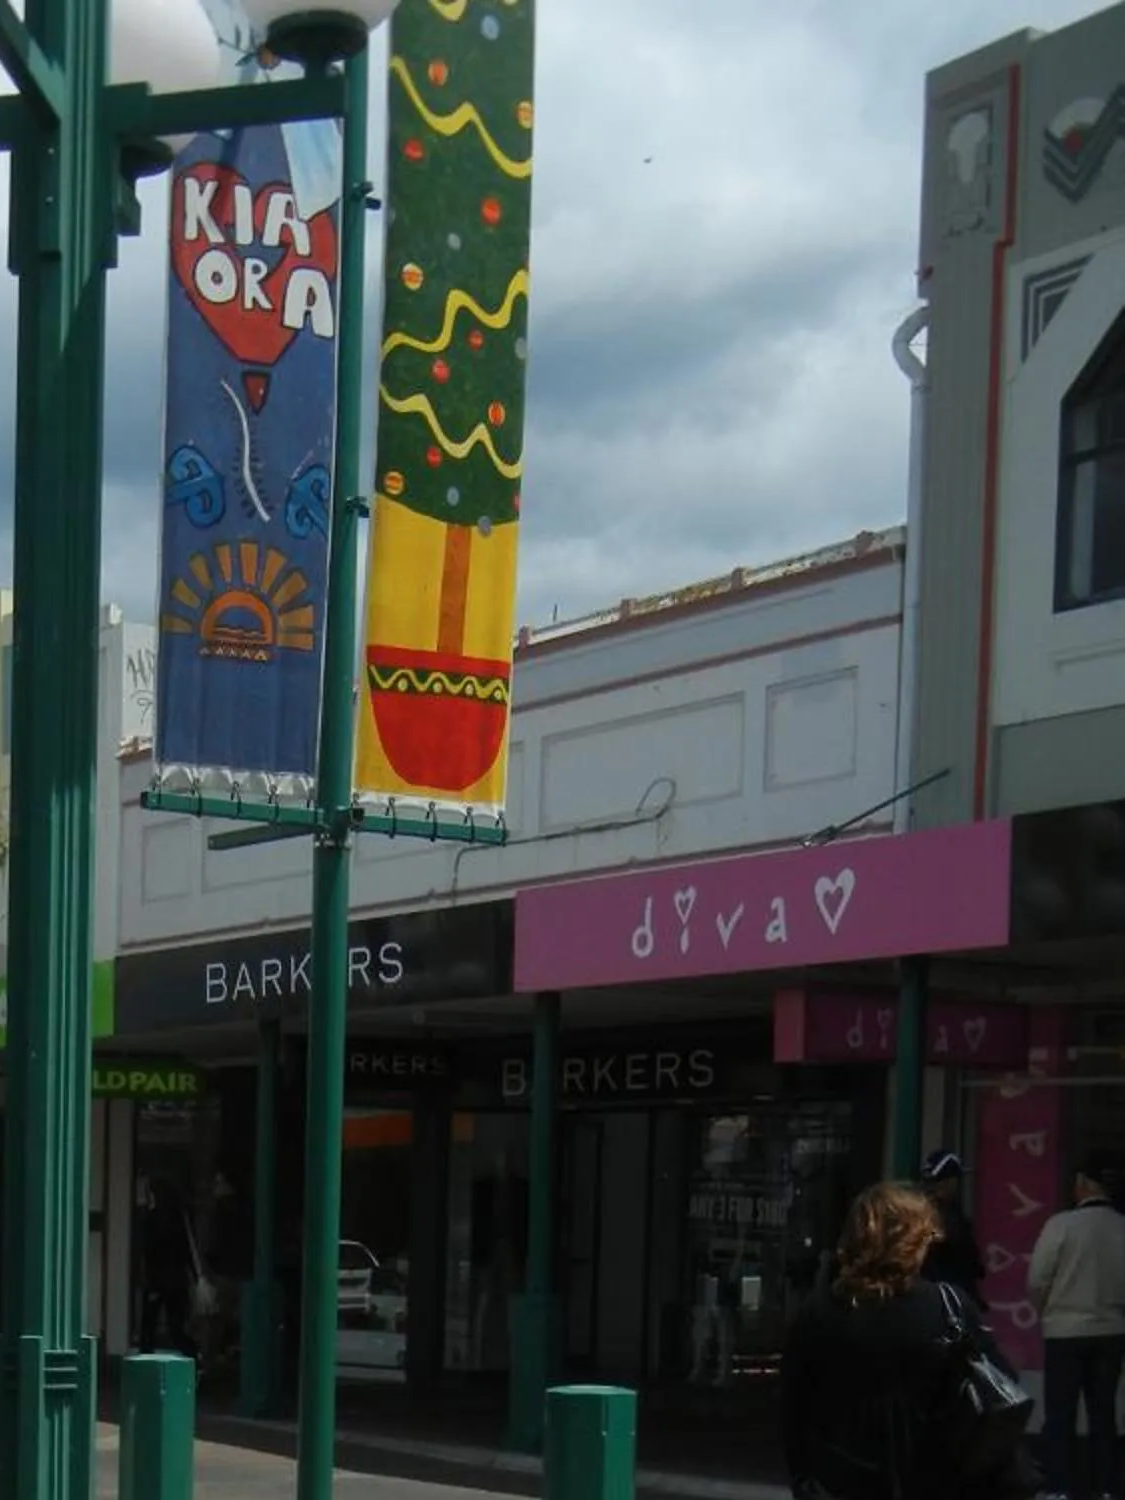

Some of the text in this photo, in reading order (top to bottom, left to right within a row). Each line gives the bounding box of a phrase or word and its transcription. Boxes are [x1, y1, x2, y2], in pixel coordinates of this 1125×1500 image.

[184, 177, 311, 257] KIA
[195, 249, 335, 339] ORA
[631, 885, 787, 958] diva
[205, 941, 404, 1003] BARKRS
[846, 1007, 949, 1052] dia
[350, 1052, 445, 1076] RKERS
[502, 1048, 715, 1097] BRKERS
